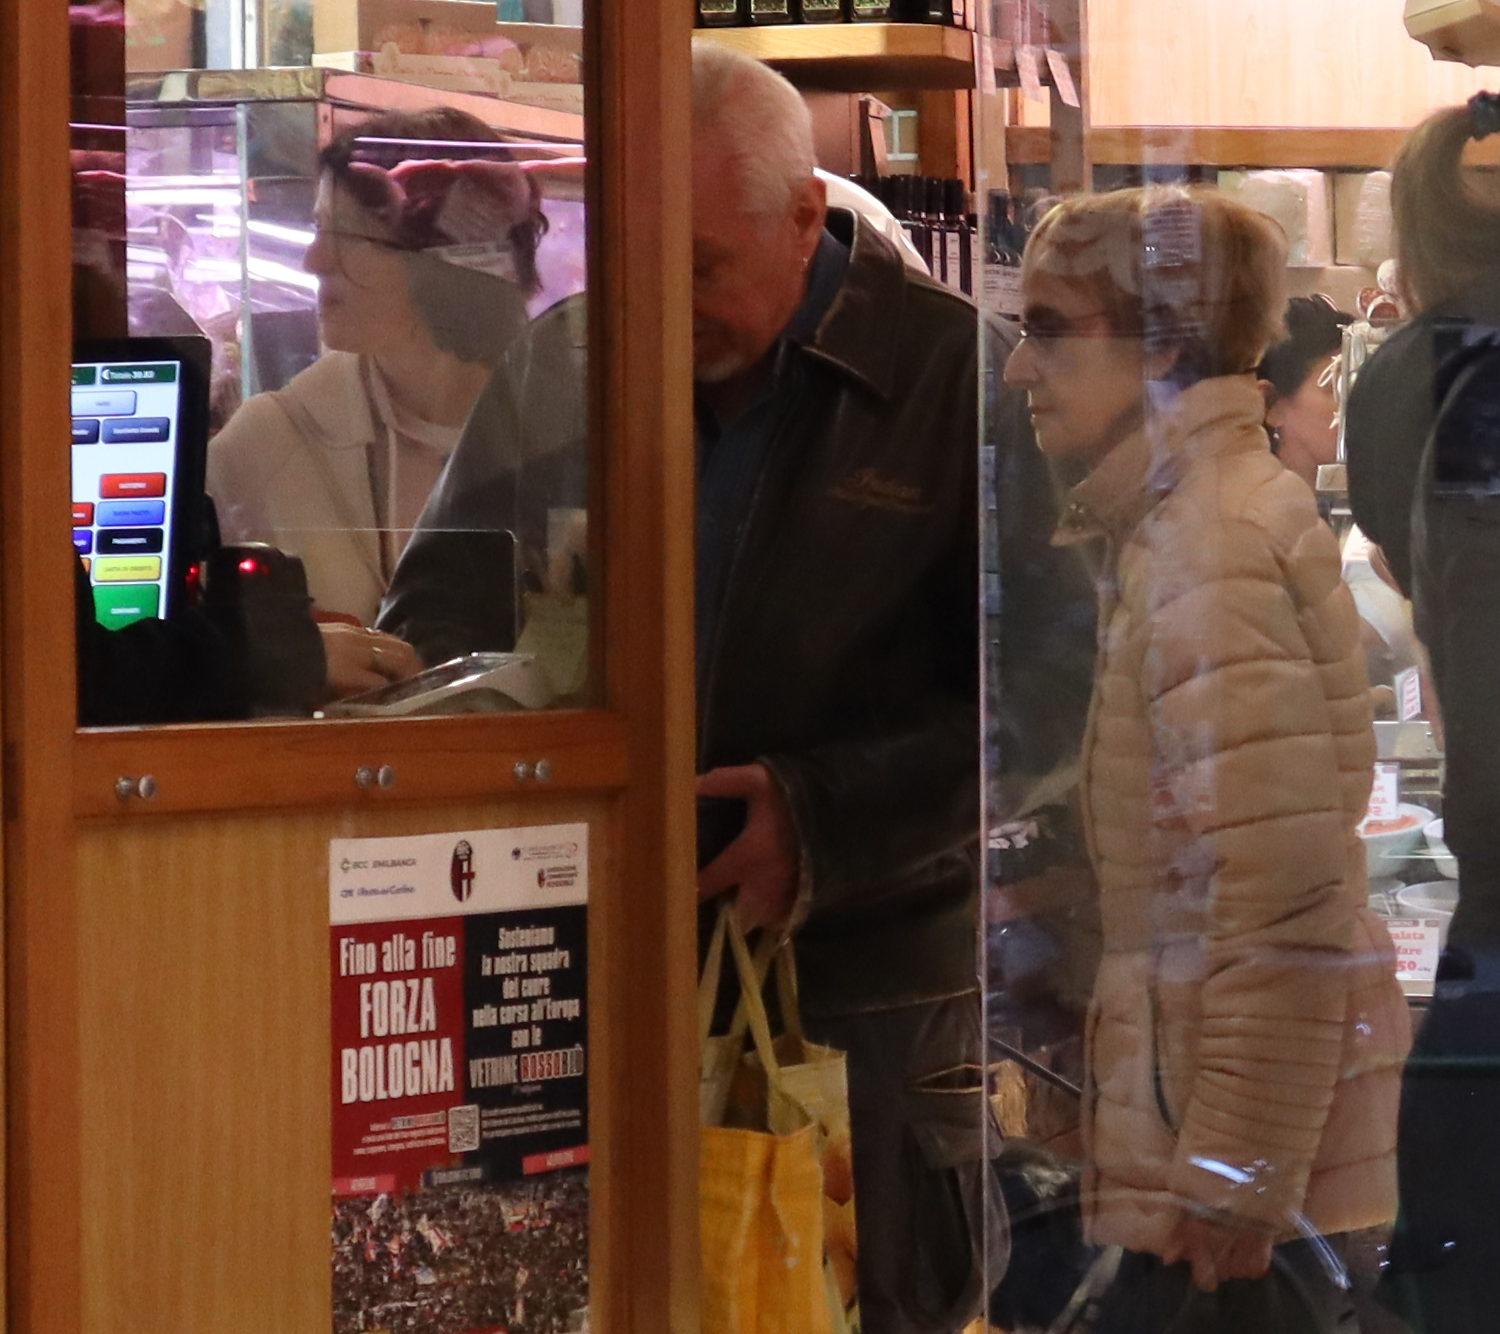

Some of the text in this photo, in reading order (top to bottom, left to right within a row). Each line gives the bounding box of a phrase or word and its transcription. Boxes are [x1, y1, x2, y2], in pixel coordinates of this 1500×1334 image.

[340, 931, 456, 977] Fino alla fine
[493, 951, 528, 975] nostra
[529, 948, 571, 974] squadra
[521, 977, 550, 998] cuore
[360, 977, 437, 1038] FORZA
[500, 1004, 529, 1026] corsa
[511, 1029, 530, 1049] con
[341, 1037, 454, 1104] BOLOGNA
